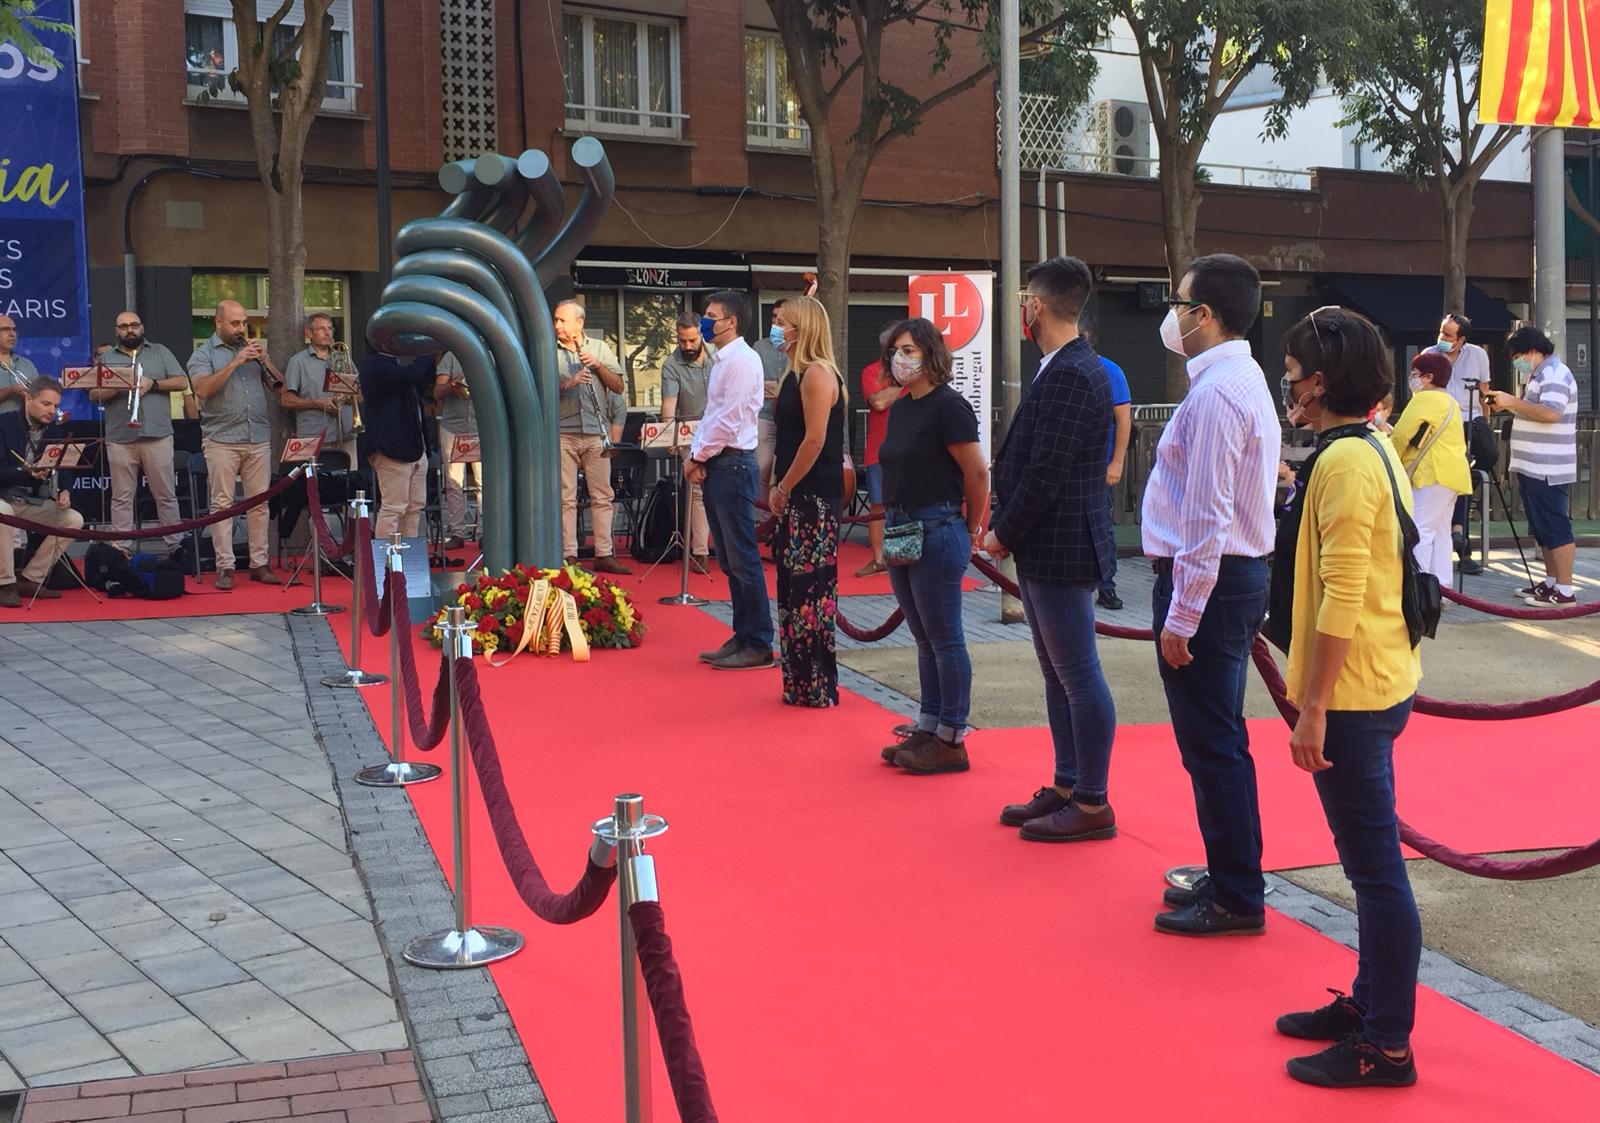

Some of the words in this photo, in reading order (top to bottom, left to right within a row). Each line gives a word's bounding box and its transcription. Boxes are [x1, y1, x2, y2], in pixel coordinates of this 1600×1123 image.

[0, 239, 23, 260] S
[636, 267, 669, 286] L'ONZE
[0, 299, 67, 319] ARIS
[917, 283, 969, 336] LL
[952, 357, 968, 394] cipal
[968, 352, 984, 424] lobregat
